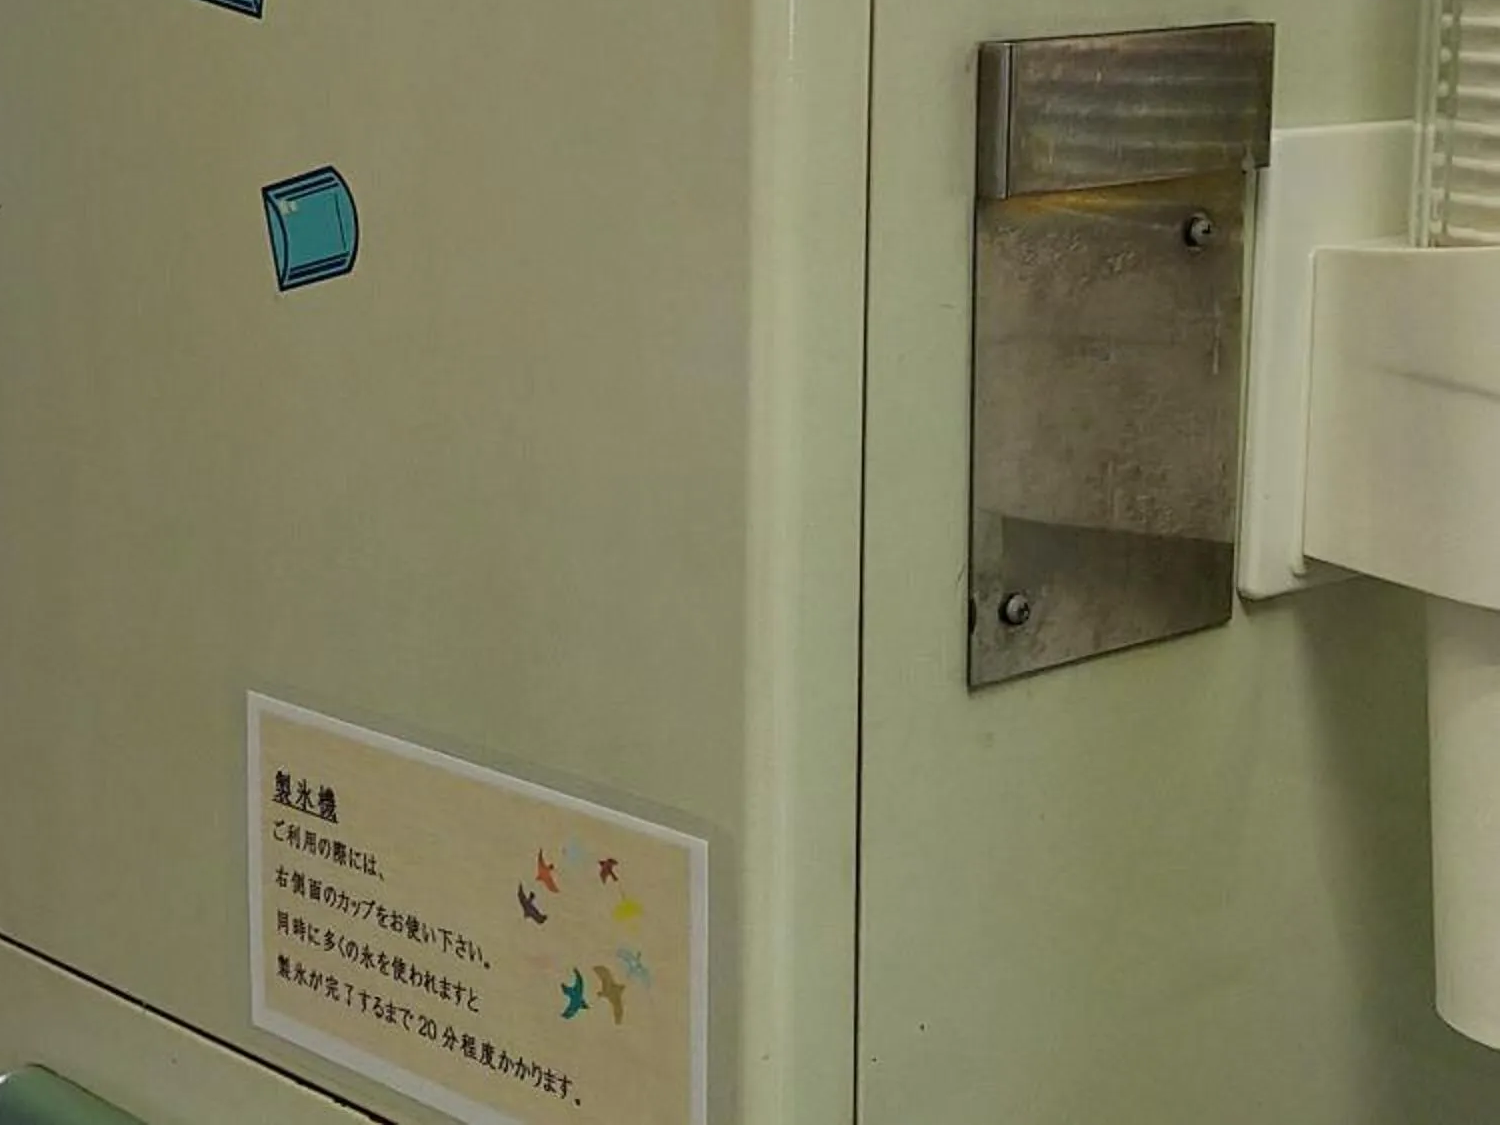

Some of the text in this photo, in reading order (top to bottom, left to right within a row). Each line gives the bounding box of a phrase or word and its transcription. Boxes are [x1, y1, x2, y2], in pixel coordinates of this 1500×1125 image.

[273, 770, 339, 823] 製氷機
[273, 820, 385, 880] ご利用の際には、
